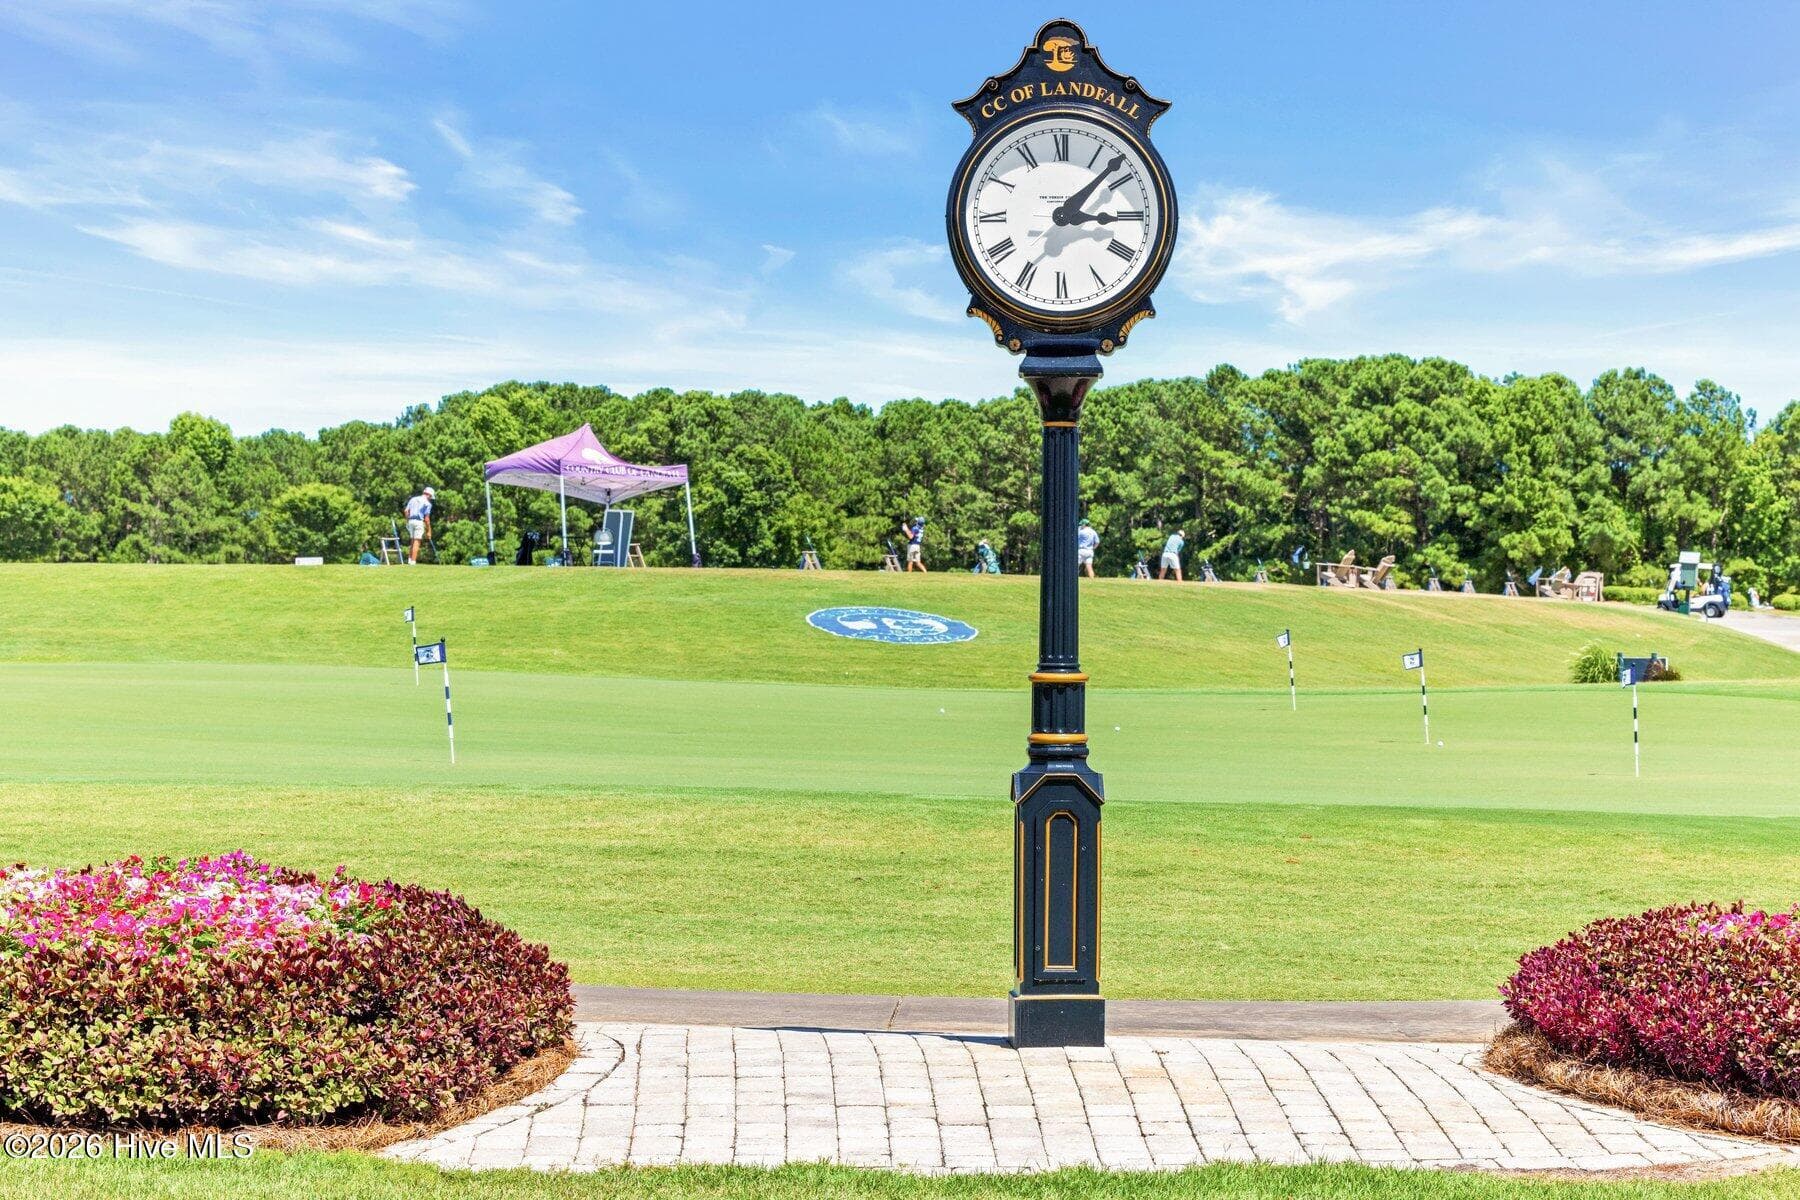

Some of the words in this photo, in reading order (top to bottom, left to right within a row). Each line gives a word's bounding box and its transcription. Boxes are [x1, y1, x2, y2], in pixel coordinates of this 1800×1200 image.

[981, 95, 1008, 118] CC
[1010, 84, 1034, 103] OF
[1040, 81, 1141, 120] LANDFALL
[1053, 134, 1069, 162] XII
